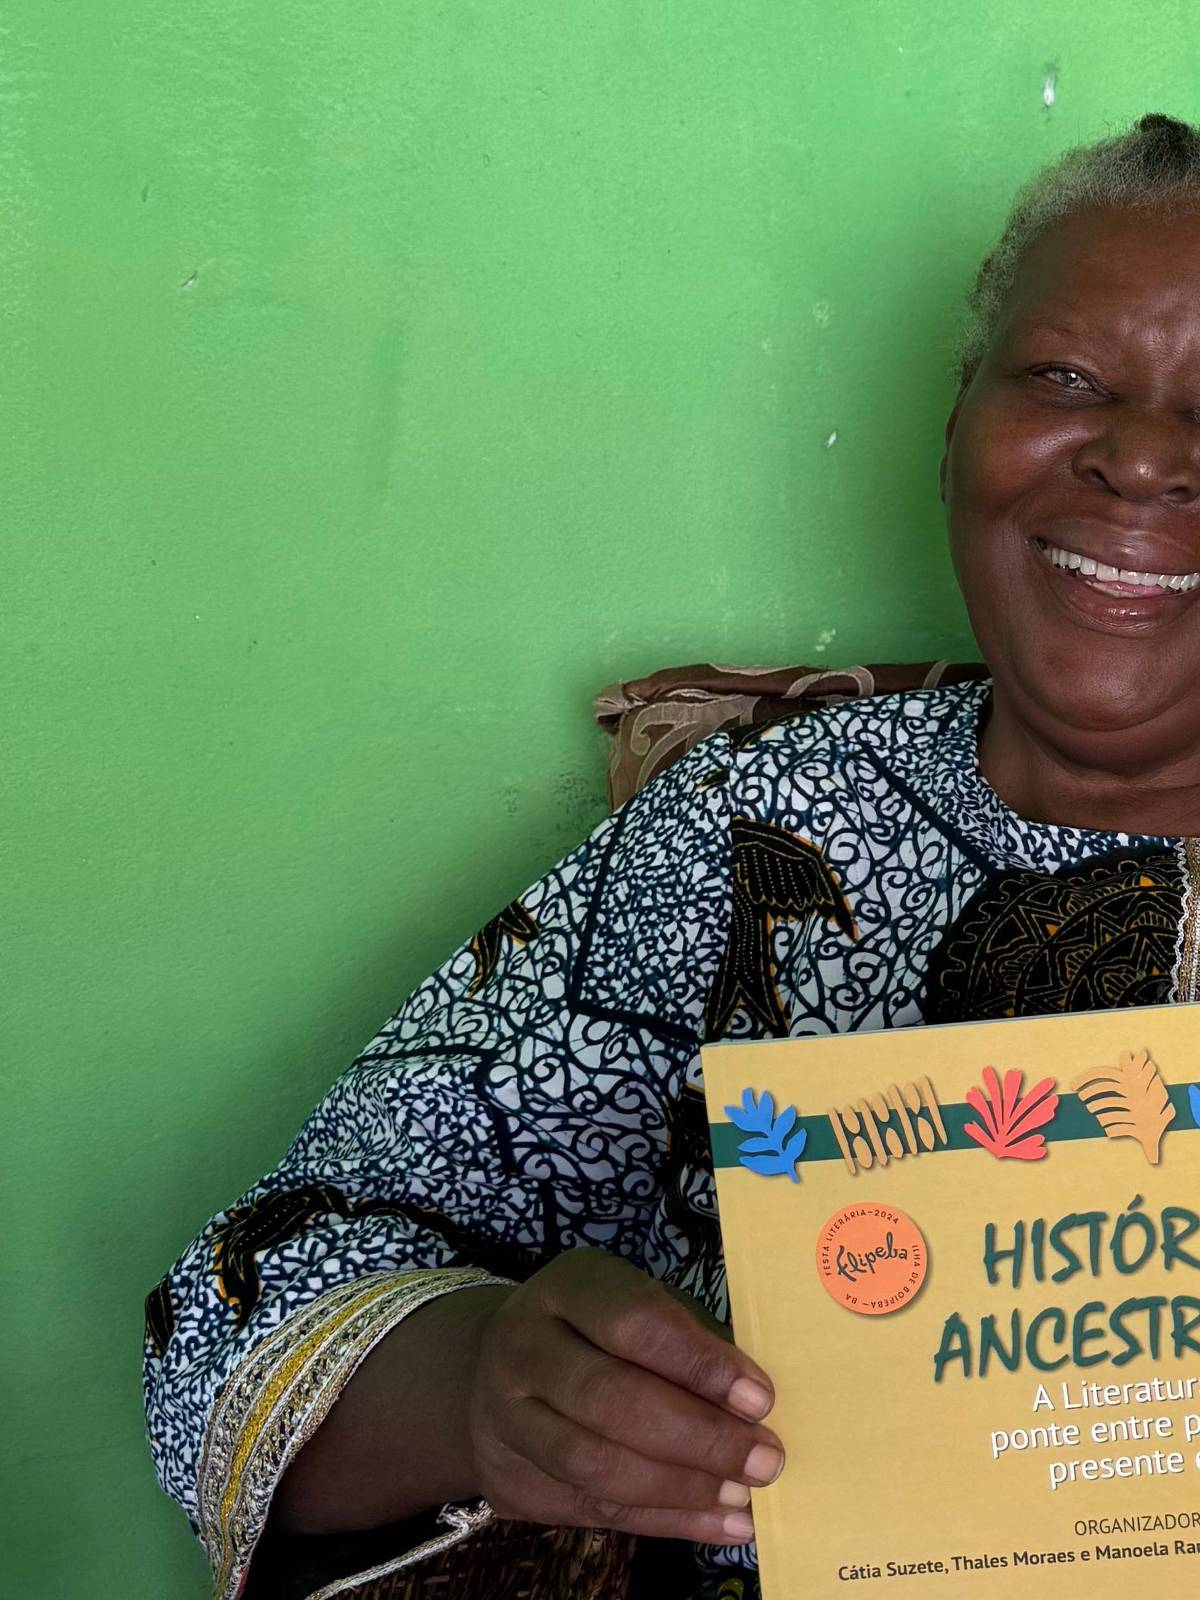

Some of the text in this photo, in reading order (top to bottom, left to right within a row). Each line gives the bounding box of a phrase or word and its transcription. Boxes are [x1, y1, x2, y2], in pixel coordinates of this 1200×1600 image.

[822, 1246, 832, 1276] FESTA
[911, 1245, 921, 1267] ILHA
[909, 1272, 919, 1284] DE
[846, 1293, 858, 1305] BA
[1032, 1383, 1055, 1412] A
[990, 1421, 1080, 1459] ponte
[1090, 1415, 1173, 1443] entre
[1049, 1450, 1185, 1490] presente
[838, 1563, 882, 1581] Cátia
[886, 1560, 950, 1577] Suzete,
[951, 1554, 1009, 1571] Thales
[1013, 1551, 1076, 1567] Moraes
[1079, 1550, 1091, 1562] e
[1095, 1541, 1169, 1561] Manoela
